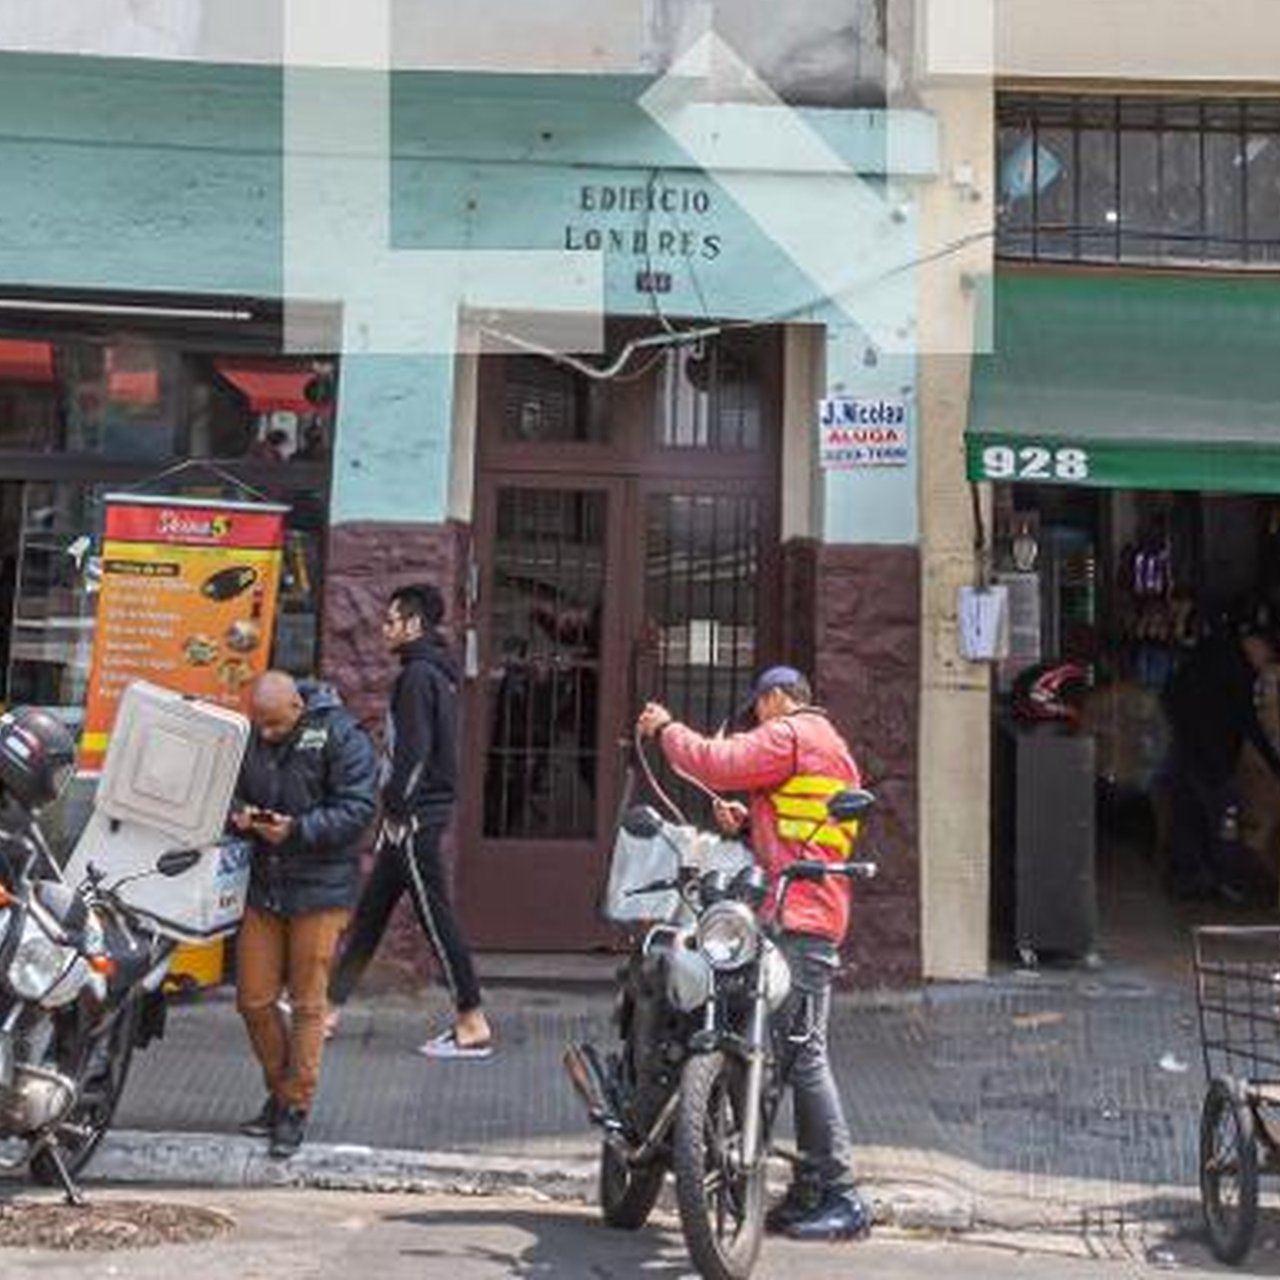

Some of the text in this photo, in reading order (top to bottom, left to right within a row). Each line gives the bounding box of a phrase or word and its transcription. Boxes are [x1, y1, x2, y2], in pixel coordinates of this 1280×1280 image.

[580, 185, 710, 214] EDIFICIO
[564, 224, 723, 261] LONDRES
[829, 428, 899, 444] ALUGA
[981, 446, 1089, 479] 928
